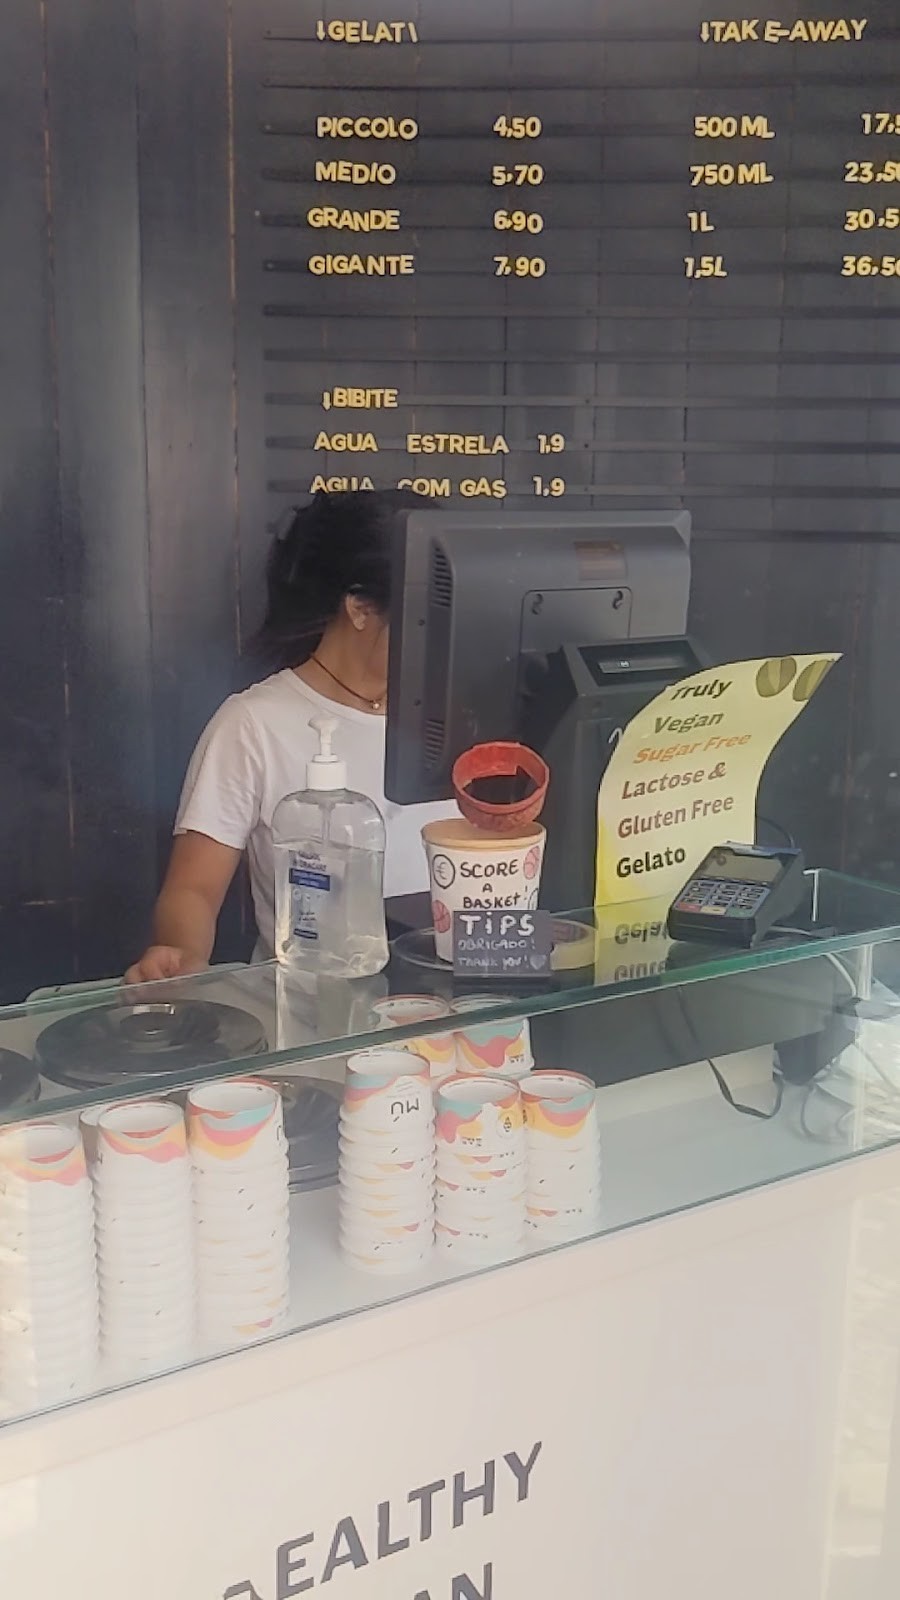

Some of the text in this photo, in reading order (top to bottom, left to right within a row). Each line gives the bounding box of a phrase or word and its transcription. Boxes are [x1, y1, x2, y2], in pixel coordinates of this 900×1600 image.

[316, 116, 542, 140] PICCOLO 4,50
[694, 116, 737, 138] 500
[741, 115, 775, 138] ML
[315, 161, 544, 186] MEDIO 5,70
[690, 164, 734, 186] 750
[737, 162, 774, 184] ML
[307, 207, 544, 234] GRANDE 6,90
[687, 211, 715, 232] 1L
[308, 254, 546, 278] GIGANTE 7,90
[684, 256, 728, 279] 1,5L
[332, 387, 398, 409] BIBITE
[314, 431, 565, 455] AGUA ESTRELA 1,9
[459, 477, 507, 499] GAS
[532, 475, 565, 497] 1,9
[670, 679, 733, 701] Truly
[654, 712, 724, 734] Vegan
[632, 734, 752, 764] Sugar Free
[621, 761, 727, 800] Lactose &
[617, 796, 735, 839] Gluten Free
[460, 858, 519, 878] SCORE
[616, 846, 686, 878] Gelato
[482, 883, 493, 893] A
